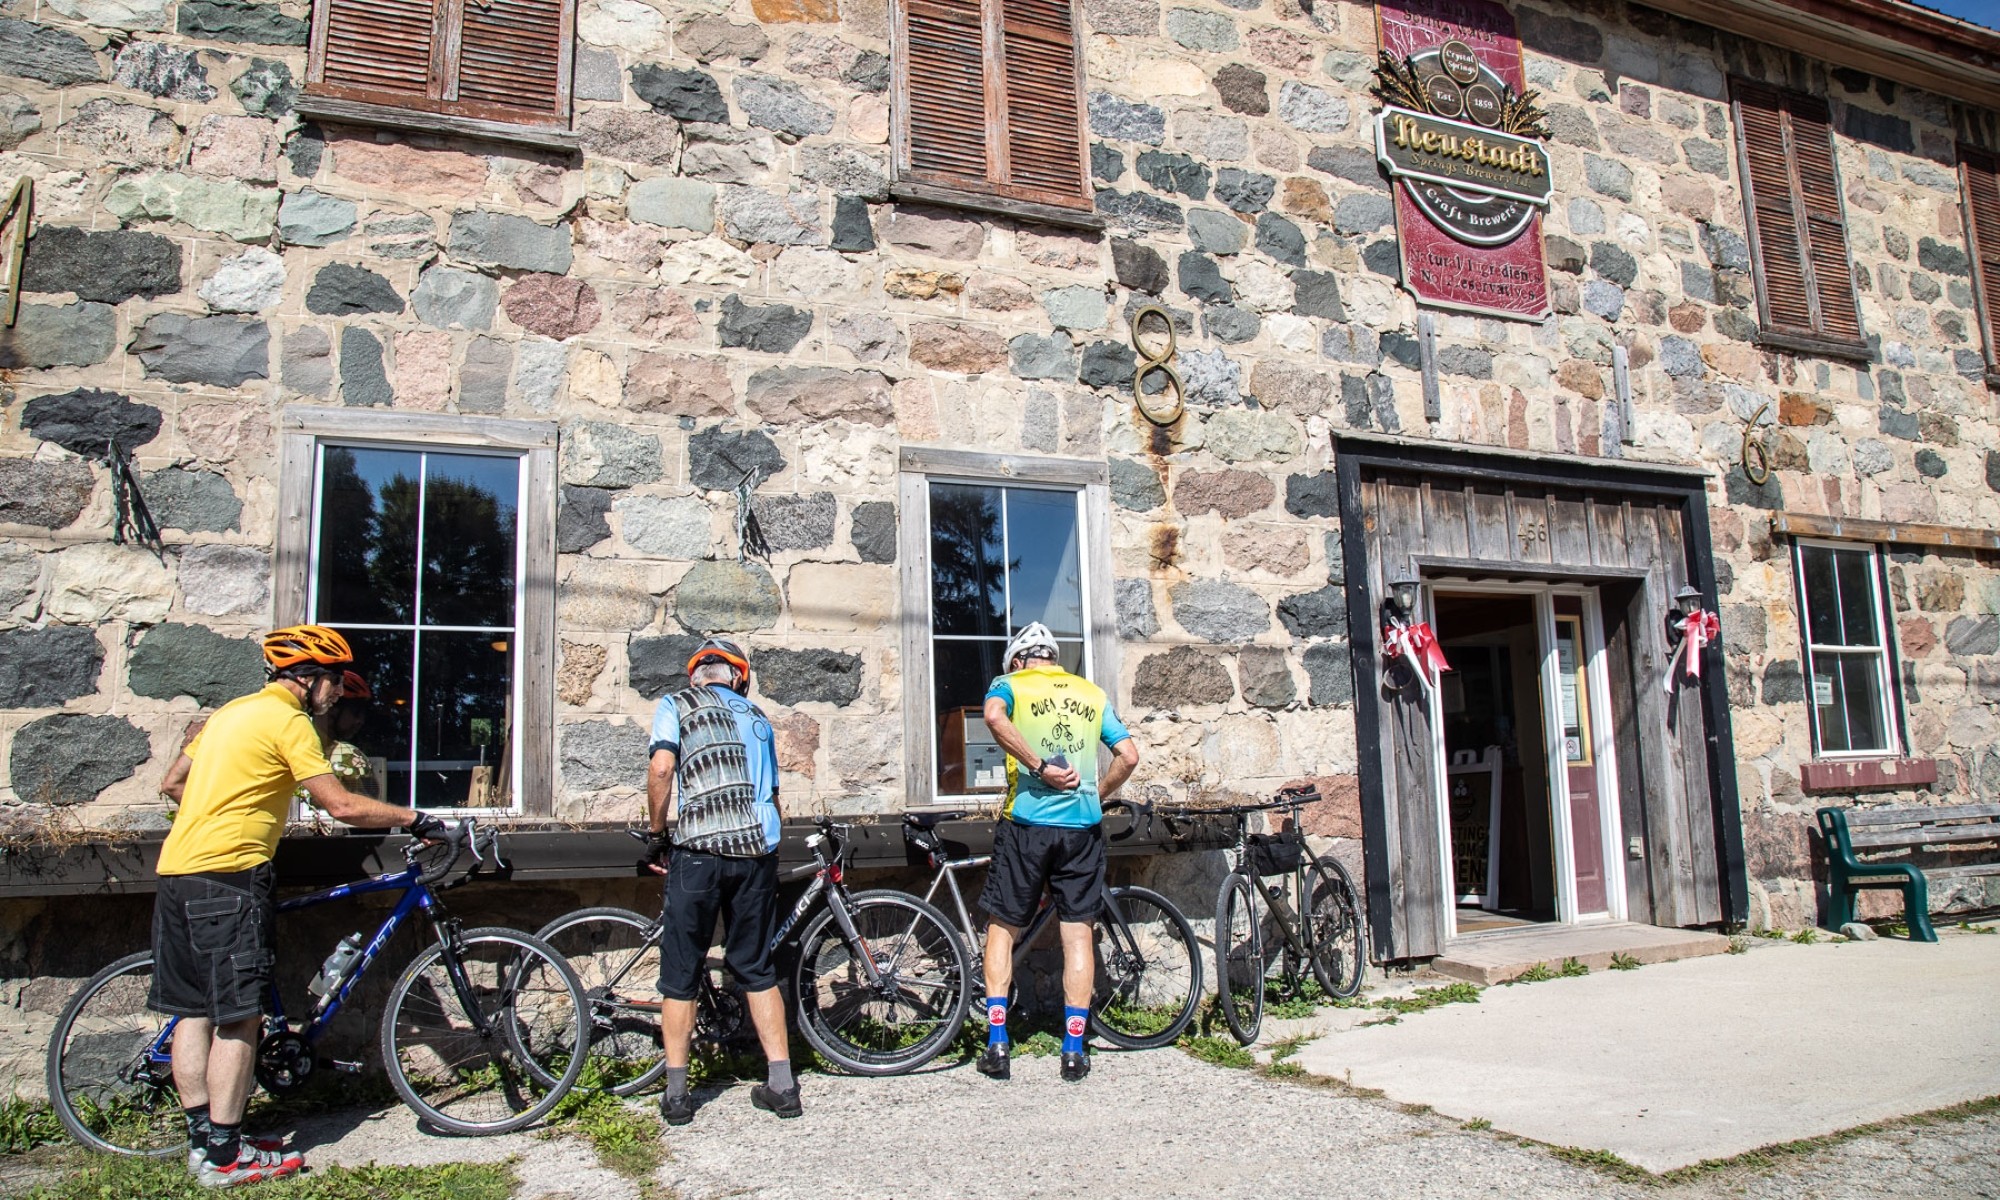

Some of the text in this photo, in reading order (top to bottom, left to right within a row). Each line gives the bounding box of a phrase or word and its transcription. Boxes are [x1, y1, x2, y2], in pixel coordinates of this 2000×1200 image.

[1446, 50, 1474, 63] Crystal
[1448, 61, 1475, 75] Springs
[1474, 98, 1494, 110] 1859
[1392, 114, 1544, 176] Neustadt
[1410, 152, 1457, 176] Springs
[1462, 163, 1512, 189] Brewery
[1426, 187, 1516, 227] Craft Brewers
[1420, 269, 1440, 285] No
[1517, 523, 1547, 542] 456
[1061, 697, 1096, 722] SOUND
[1069, 739, 1085, 754] CLUB
